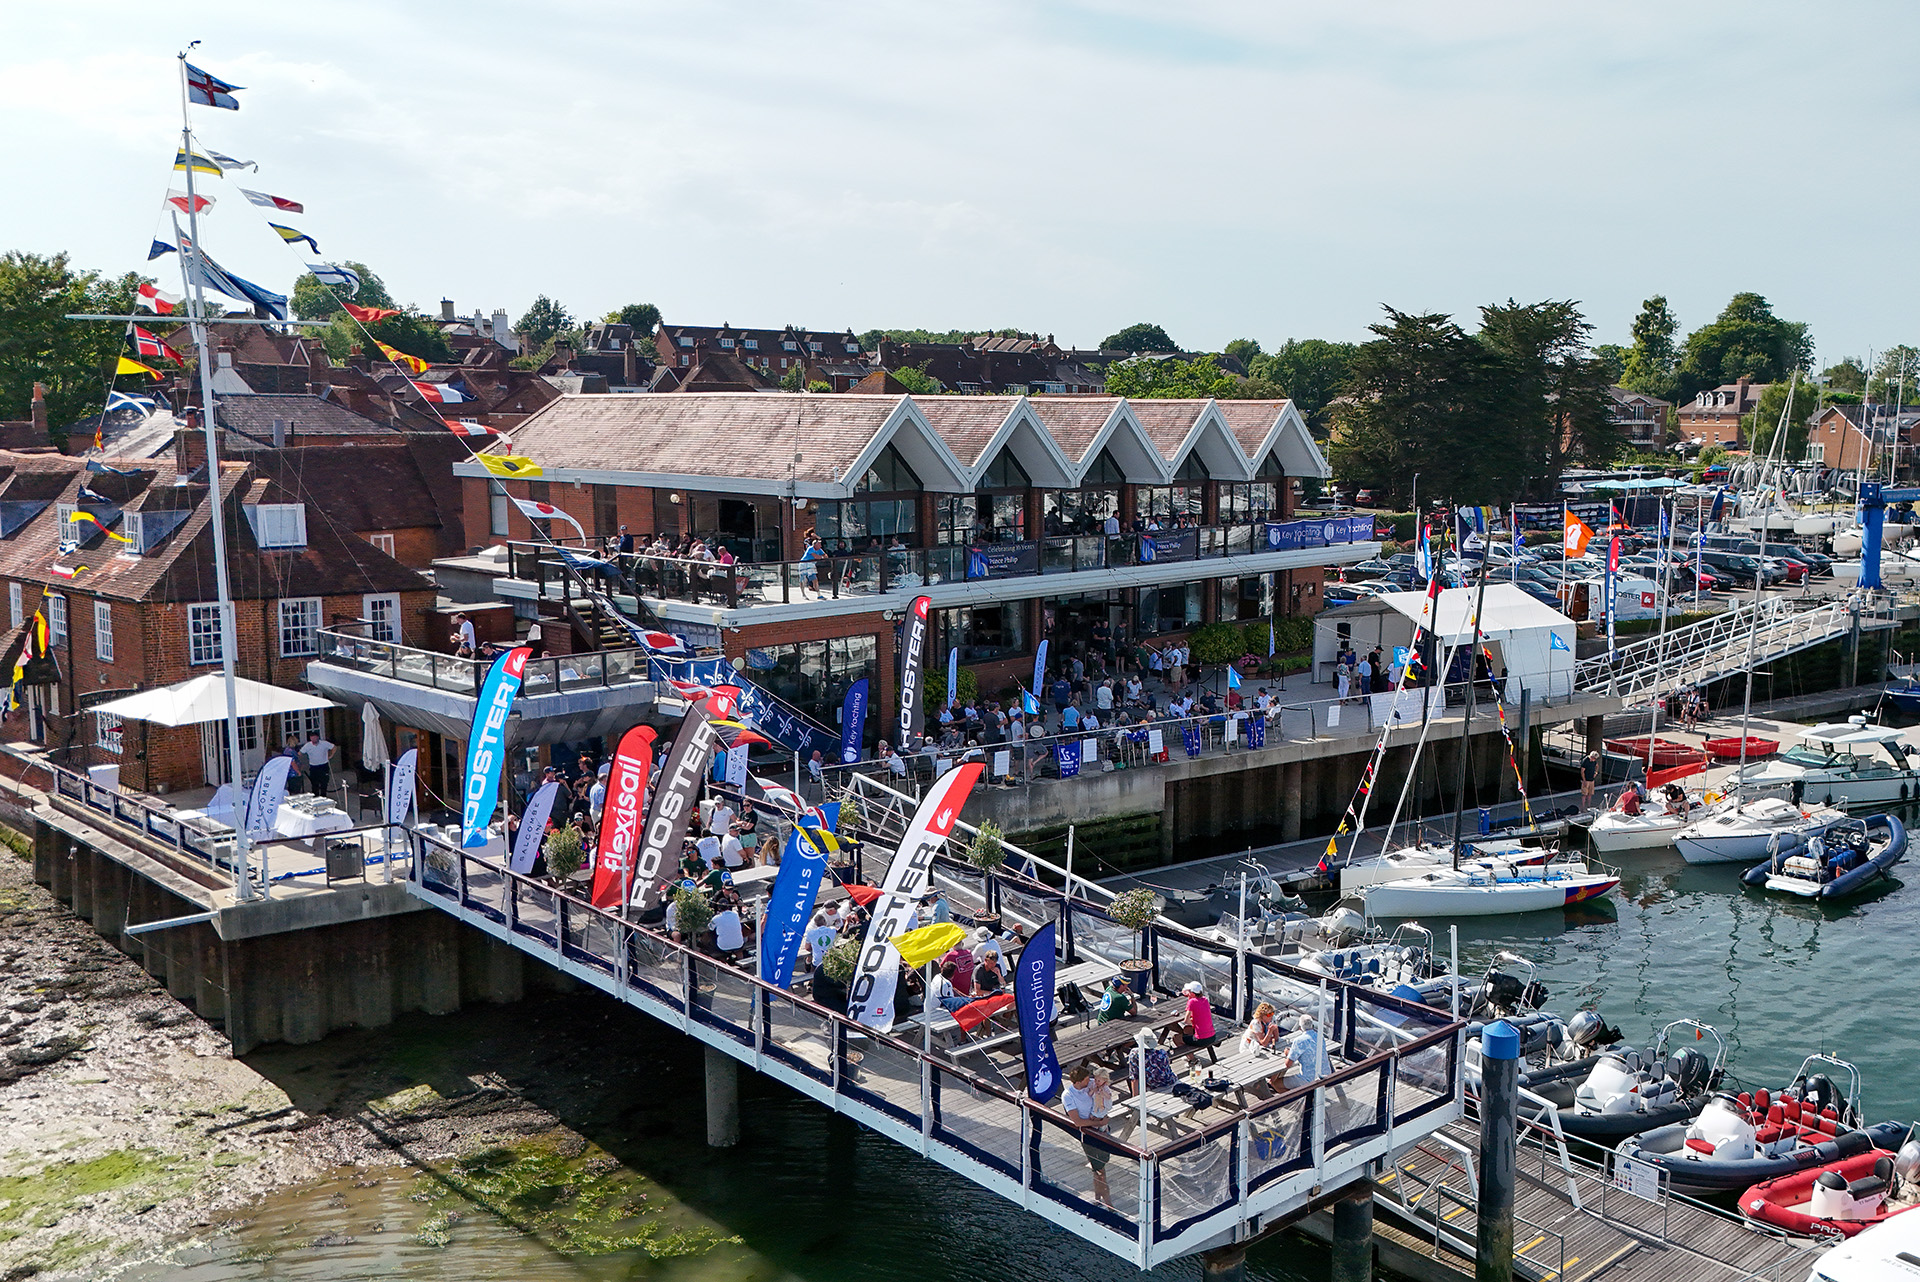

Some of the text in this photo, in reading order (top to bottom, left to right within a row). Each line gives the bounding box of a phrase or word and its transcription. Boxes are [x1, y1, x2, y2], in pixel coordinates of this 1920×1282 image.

[1281, 528, 1321, 540] Key Yachting
[1336, 523, 1373, 536] Key Yachting
[1616, 591, 1641, 601] OSTER
[901, 619, 925, 749] ROOSTER
[848, 692, 863, 745] Key Yachting
[253, 775, 272, 830] SALCOMBE
[266, 796, 276, 814] GIN
[395, 771, 405, 820] ALCOMBE
[604, 754, 642, 873] flexisail
[631, 719, 716, 908] ROOSTER
[519, 802, 540, 862] SALCOMBE
[532, 824, 542, 844] GIN
[772, 867, 812, 987] ORTH SAILS
[848, 841, 936, 1021] ROOSTER
[1031, 959, 1048, 1063] Key Yachting
